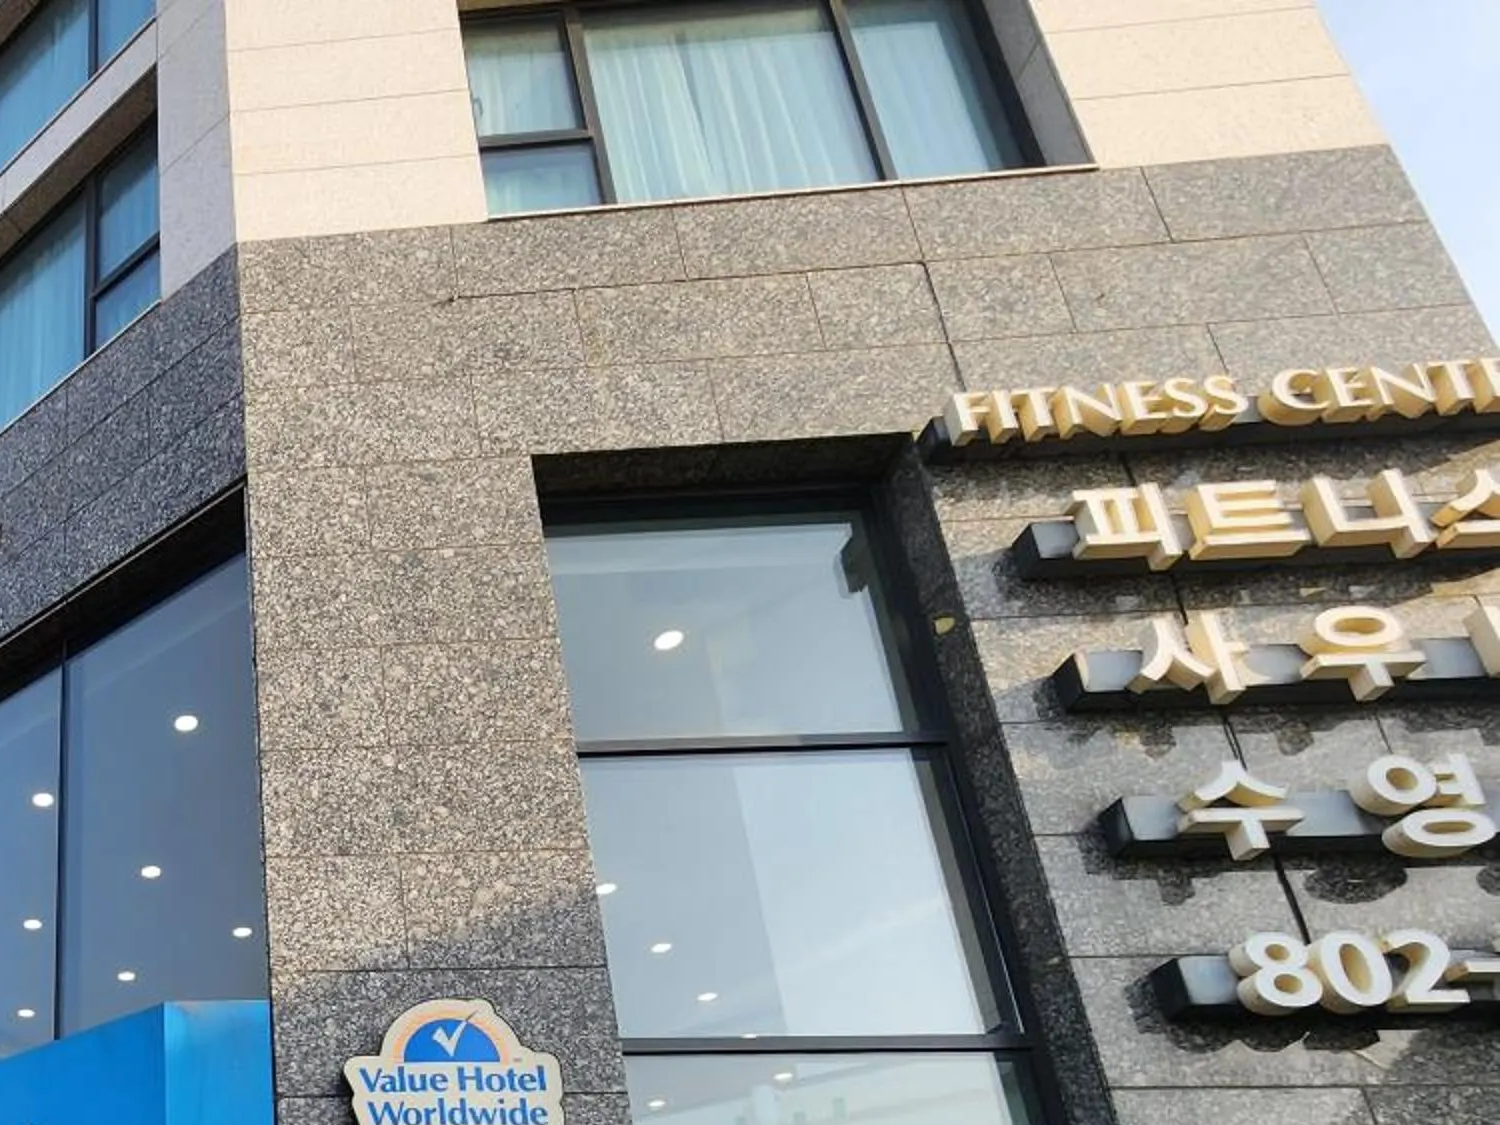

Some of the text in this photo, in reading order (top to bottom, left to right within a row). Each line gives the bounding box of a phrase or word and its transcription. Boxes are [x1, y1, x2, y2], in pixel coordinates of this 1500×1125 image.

[948, 374, 1248, 446] FITNESS
[1128, 604, 1500, 704] 사우
[359, 1064, 547, 1093] Value Hotel
